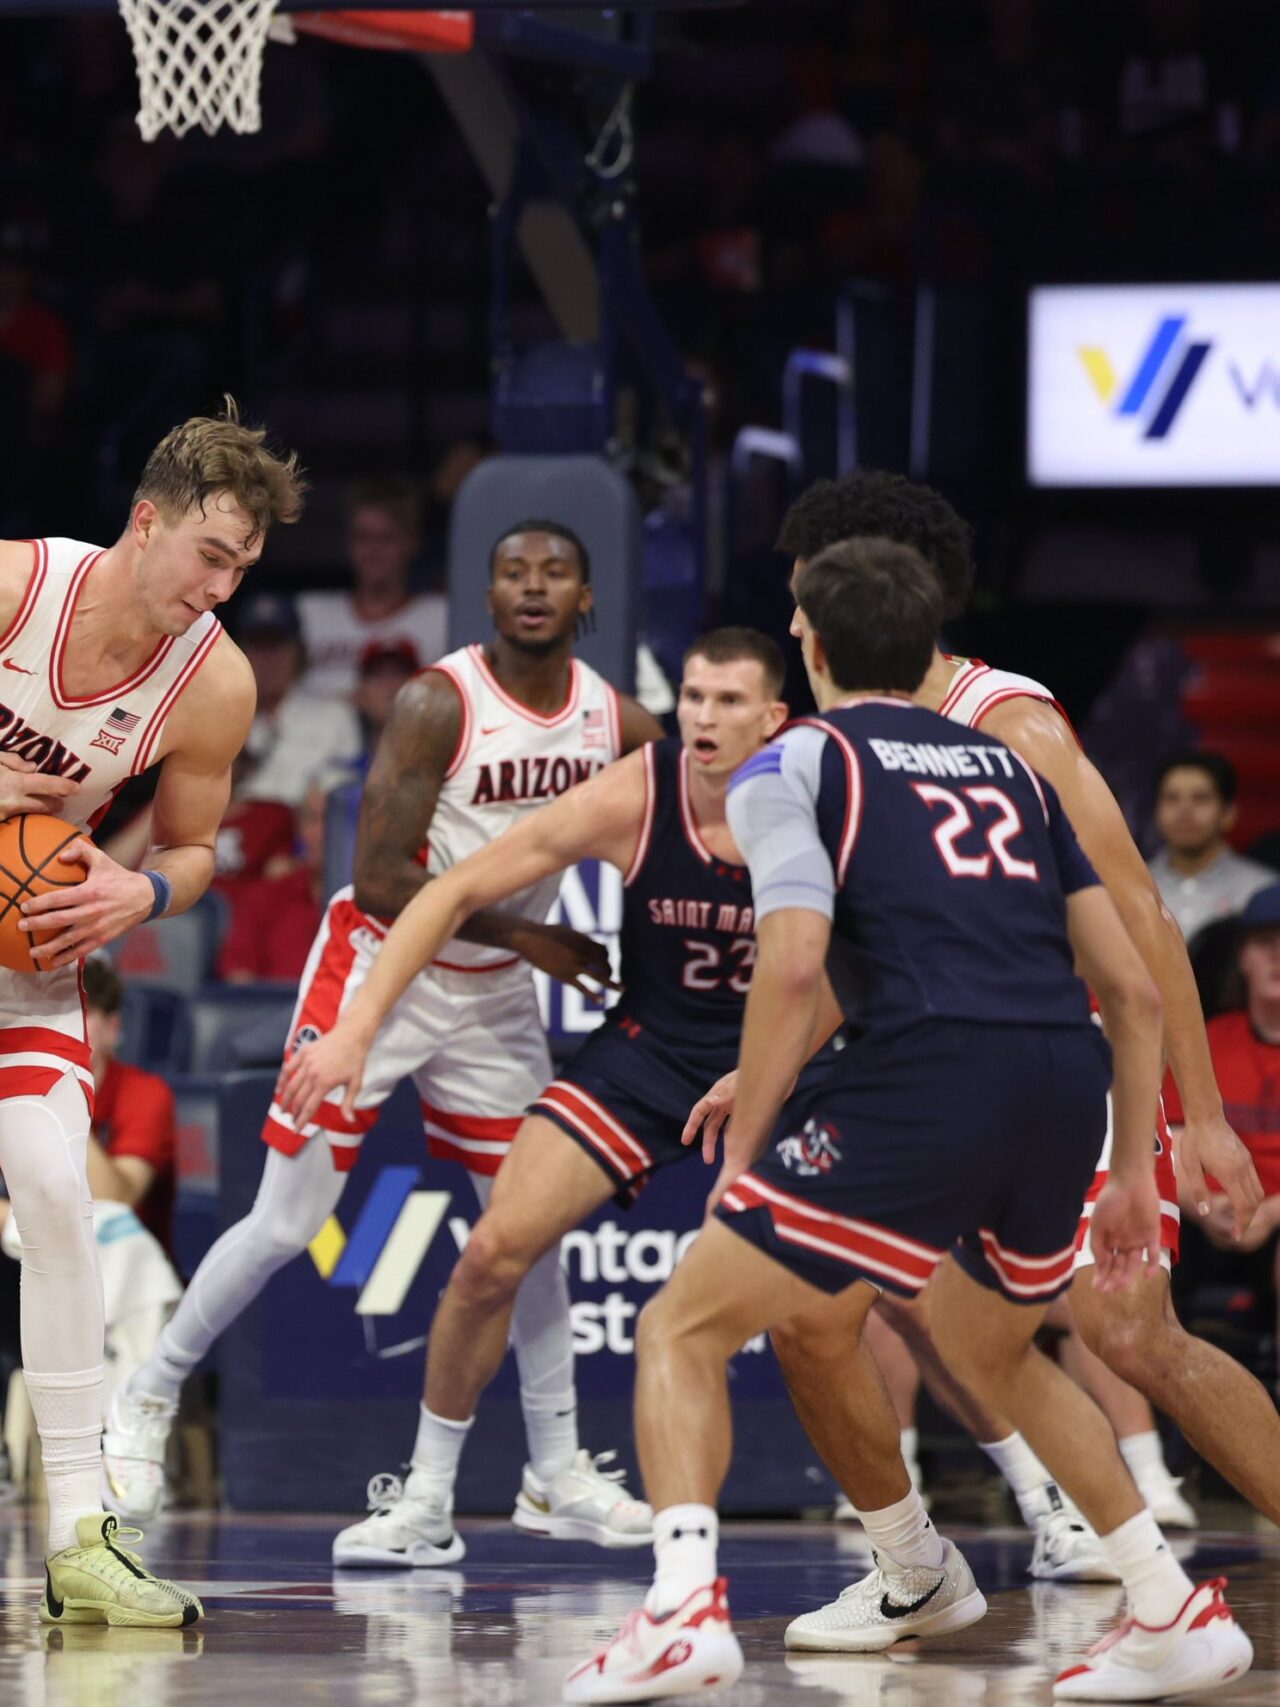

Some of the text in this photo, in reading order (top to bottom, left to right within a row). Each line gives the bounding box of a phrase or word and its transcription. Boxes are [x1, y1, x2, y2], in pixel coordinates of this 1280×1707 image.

[471, 757, 605, 806] ARIZON
[868, 738, 1014, 778] BENNETT
[910, 781, 1039, 882] 22
[648, 898, 754, 934] SAINT MA
[681, 938, 757, 993] 23
